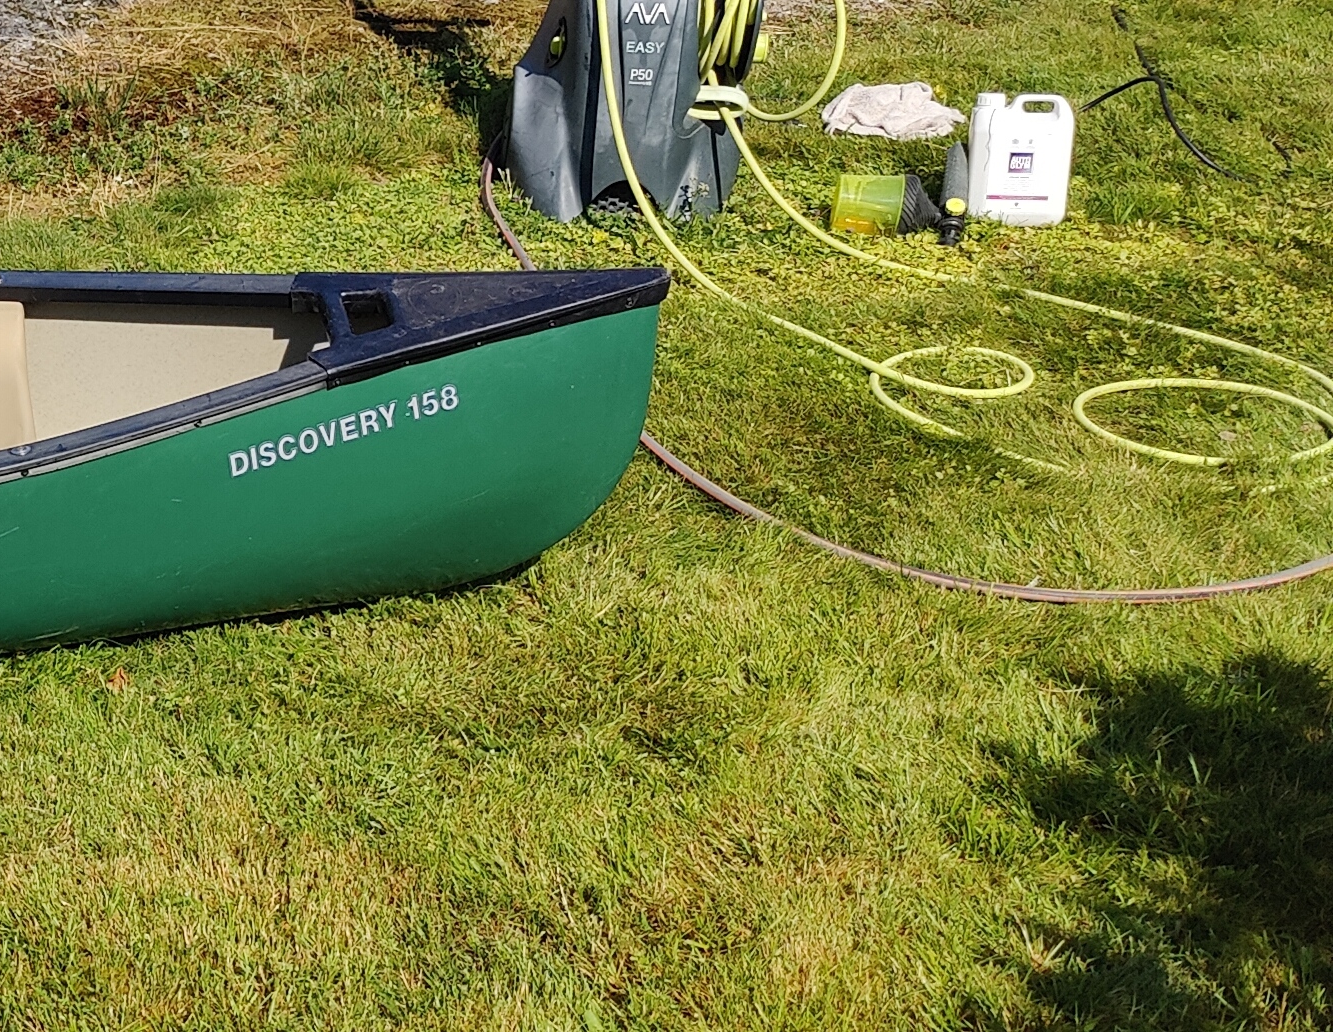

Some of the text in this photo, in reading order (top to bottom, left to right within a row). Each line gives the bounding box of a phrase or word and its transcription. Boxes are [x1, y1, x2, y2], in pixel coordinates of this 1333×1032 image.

[624, 2, 671, 25] AVA
[625, 41, 665, 54] EASY
[629, 68, 654, 81] P50
[228, 384, 460, 478] DISCOVERY 158
